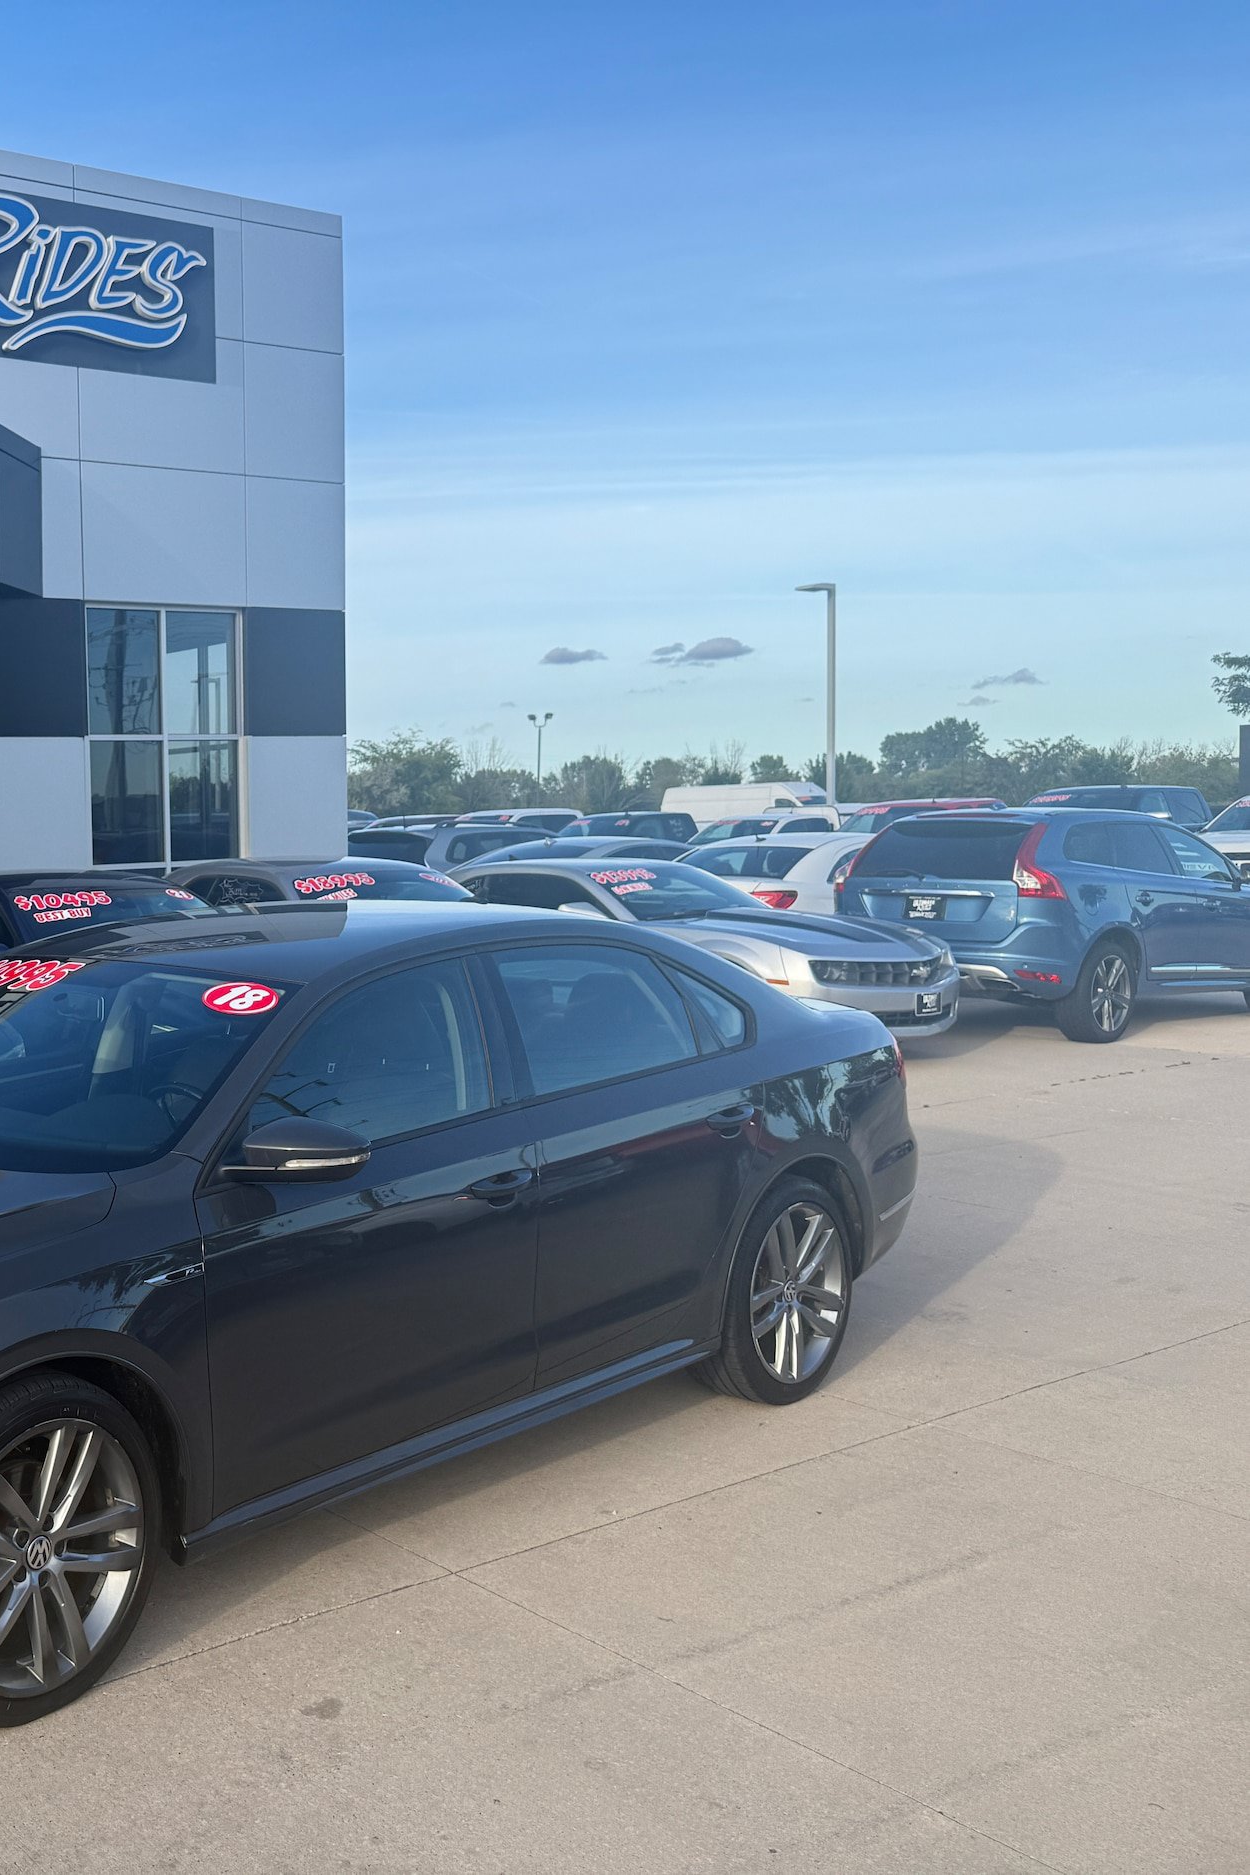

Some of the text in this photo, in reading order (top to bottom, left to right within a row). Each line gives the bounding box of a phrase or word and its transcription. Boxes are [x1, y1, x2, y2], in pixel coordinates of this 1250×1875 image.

[294, 873, 375, 893] $18995
[14, 891, 112, 911] $10495
[34, 907, 91, 923] BEST BUY
[213, 986, 271, 1010] 18
